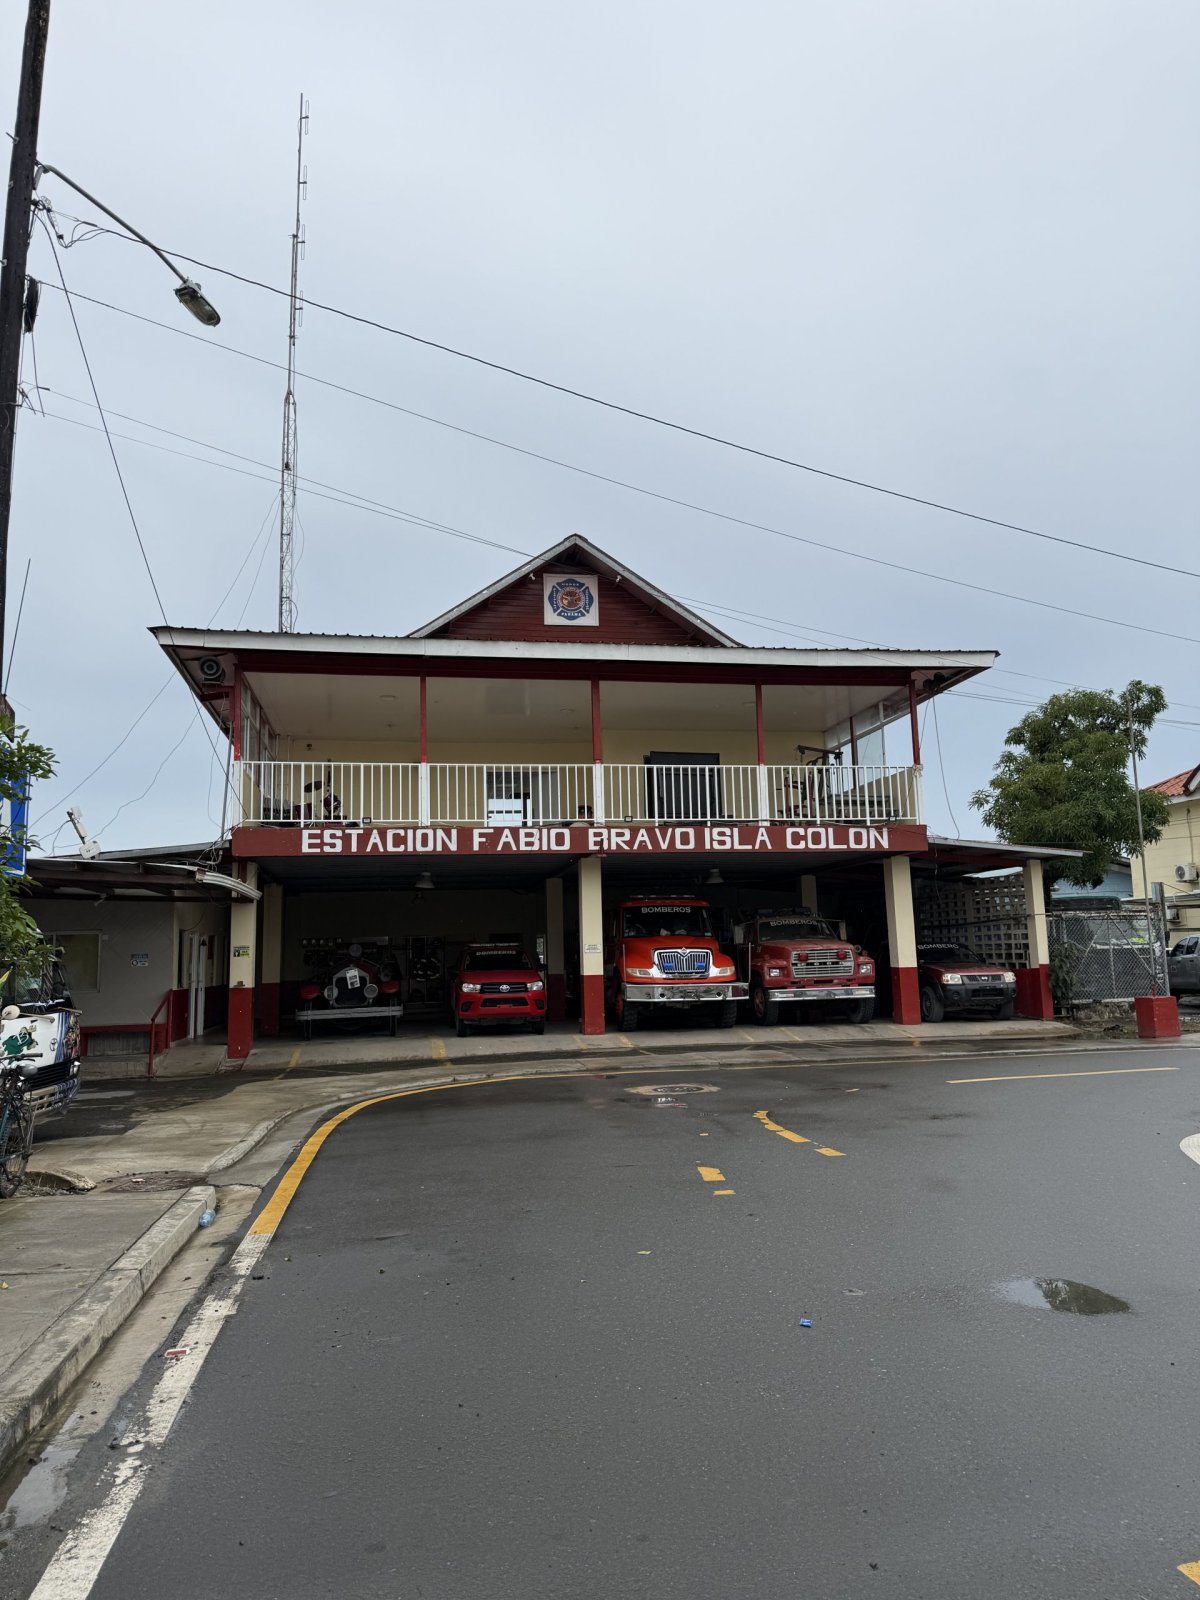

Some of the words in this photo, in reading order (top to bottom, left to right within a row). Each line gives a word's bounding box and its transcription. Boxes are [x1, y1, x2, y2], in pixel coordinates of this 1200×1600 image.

[302, 829, 458, 853] ESTACION
[473, 828, 571, 851] FABIO
[588, 827, 695, 851] BRAVO
[704, 827, 773, 850] ISLA
[786, 827, 889, 849] COLON
[641, 906, 691, 914] BOMBEROS
